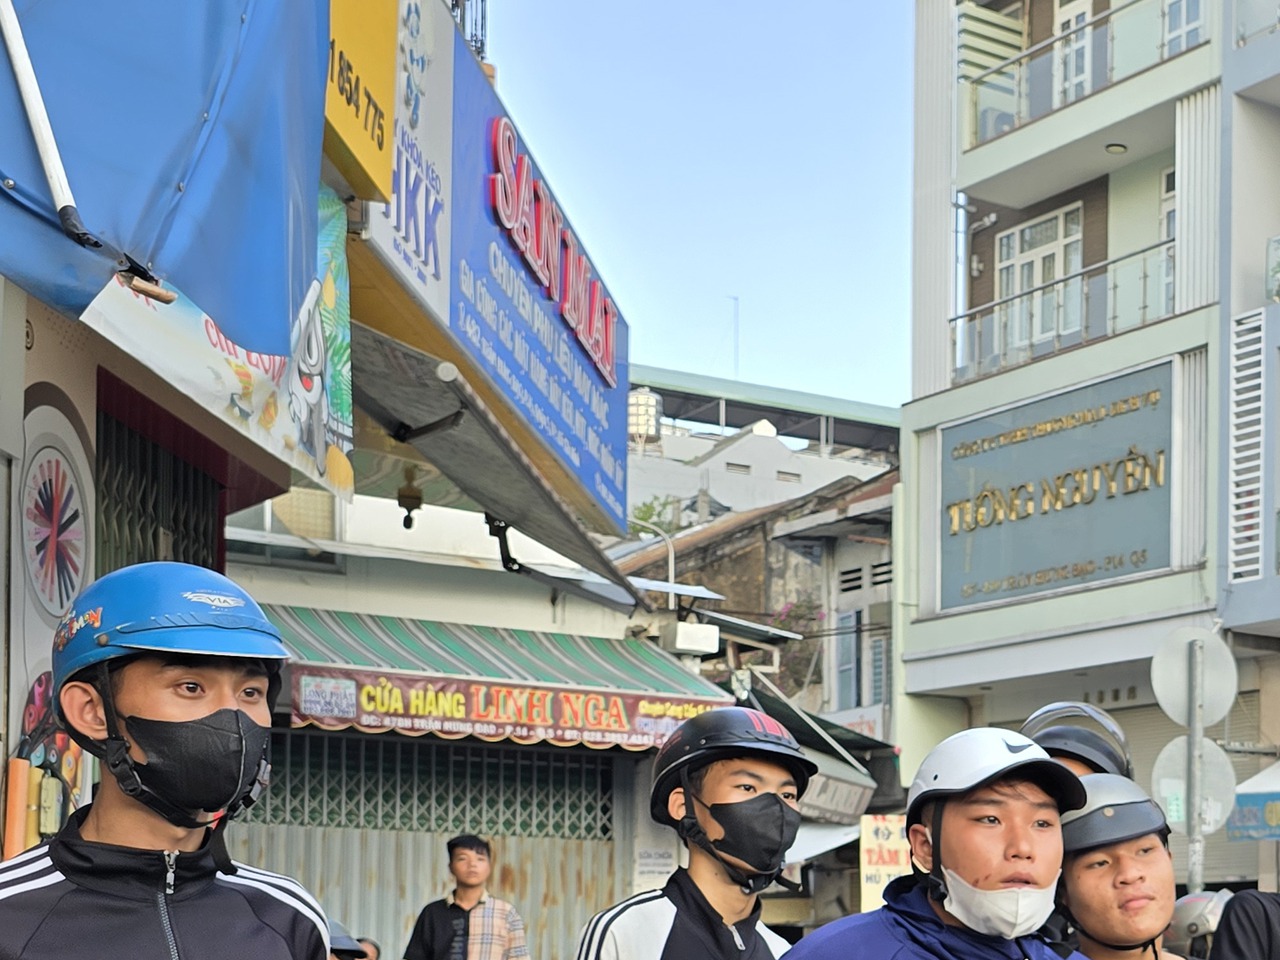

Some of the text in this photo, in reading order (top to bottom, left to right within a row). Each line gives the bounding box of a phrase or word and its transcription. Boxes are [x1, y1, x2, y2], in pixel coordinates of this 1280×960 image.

[337, 50, 361, 119] 854
[363, 86, 385, 152] 775
[401, 136, 442, 195] KHÓA KÉO
[490, 117, 563, 303] SAN
[560, 228, 617, 388] MAI
[361, 676, 405, 716] CỬA
[409, 683, 466, 719] HÀNG
[470, 684, 555, 727] LINH
[558, 691, 631, 733] NGA
